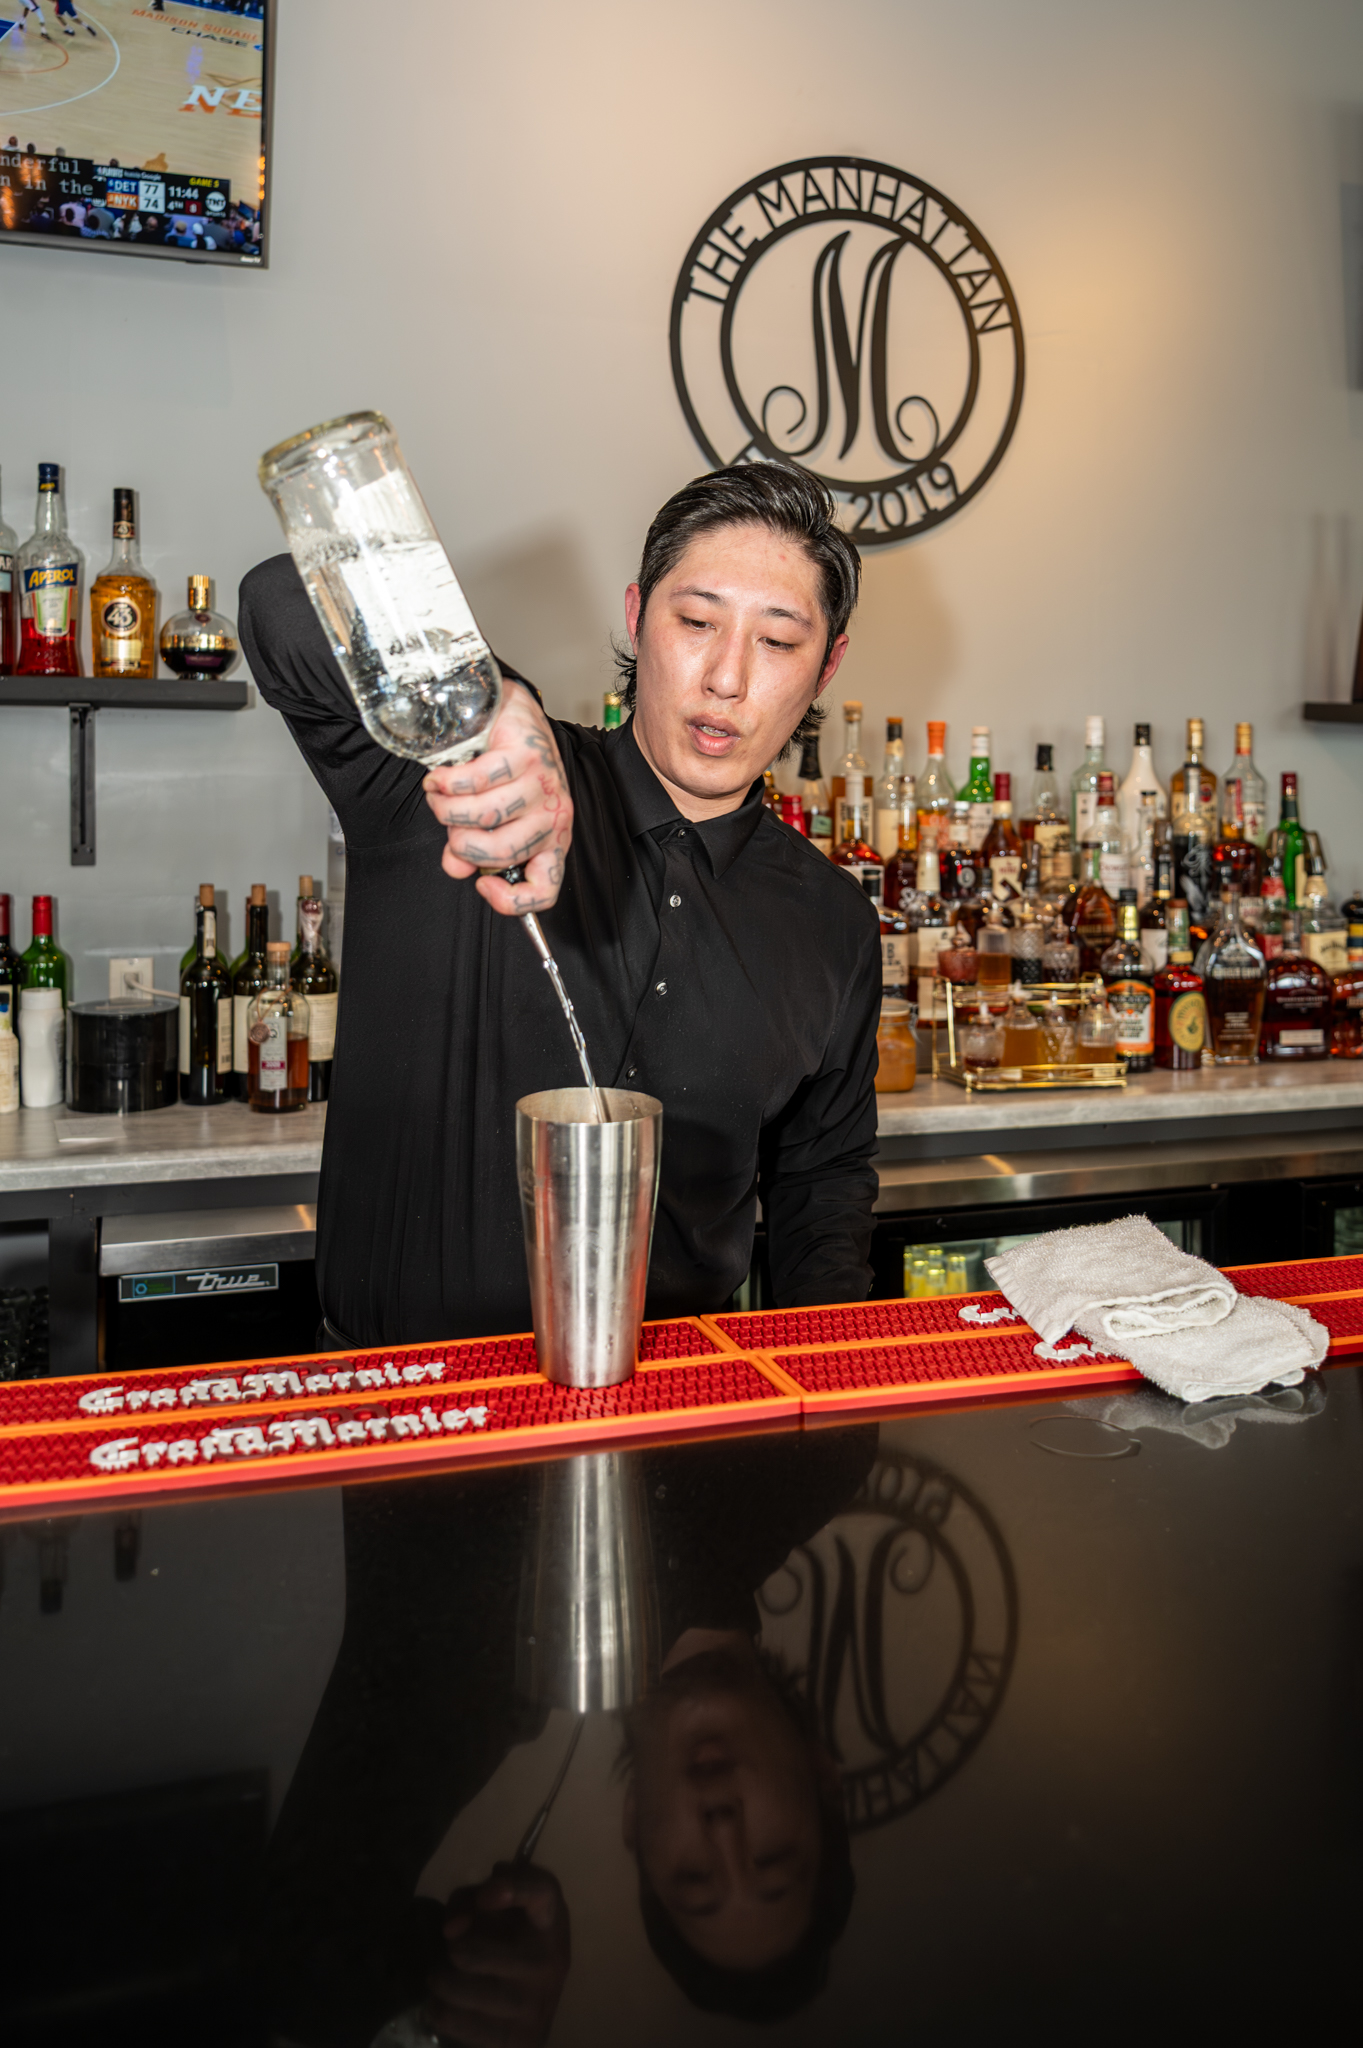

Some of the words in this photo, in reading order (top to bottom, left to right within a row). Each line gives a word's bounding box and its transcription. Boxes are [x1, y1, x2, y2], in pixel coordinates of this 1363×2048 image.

[171, 26, 248, 48] CHASE
[0, 152, 80, 175] nderful
[59, 178, 94, 196] the
[114, 180, 138, 193] DET
[144, 183, 159, 195] 77
[168, 185, 199, 200] 11:44
[114, 194, 137, 208] NYK
[144, 198, 159, 209] 74
[683, 210, 763, 305] THE
[756, 166, 1016, 336] MANHATTAN
[850, 462, 961, 533] 2019
[28, 568, 75, 589] APEROL
[107, 607, 132, 627] 43
[241, 1361, 447, 1401] Marnier
[267, 1404, 489, 1453] Marnier
